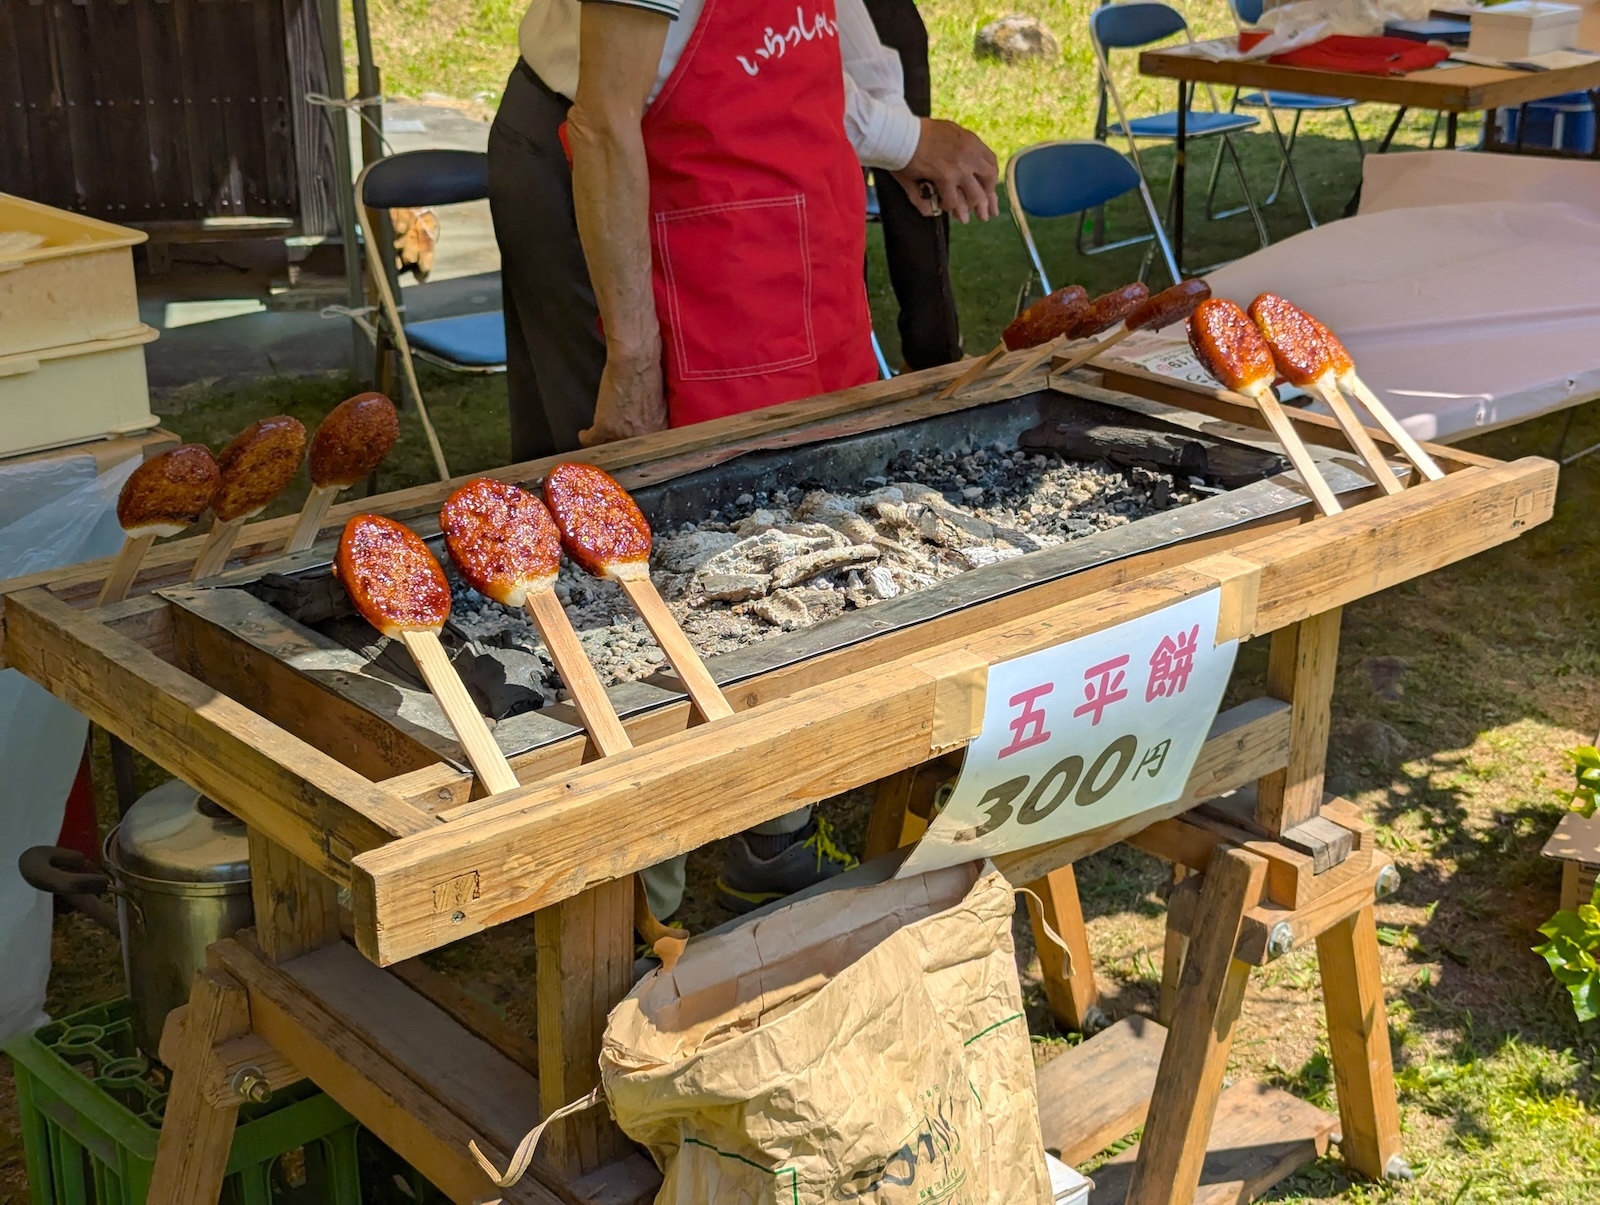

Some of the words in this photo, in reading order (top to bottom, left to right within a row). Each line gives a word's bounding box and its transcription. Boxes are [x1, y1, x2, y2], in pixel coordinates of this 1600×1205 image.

[997, 623, 1200, 760] 五平餅
[952, 734, 1172, 844] 300円
